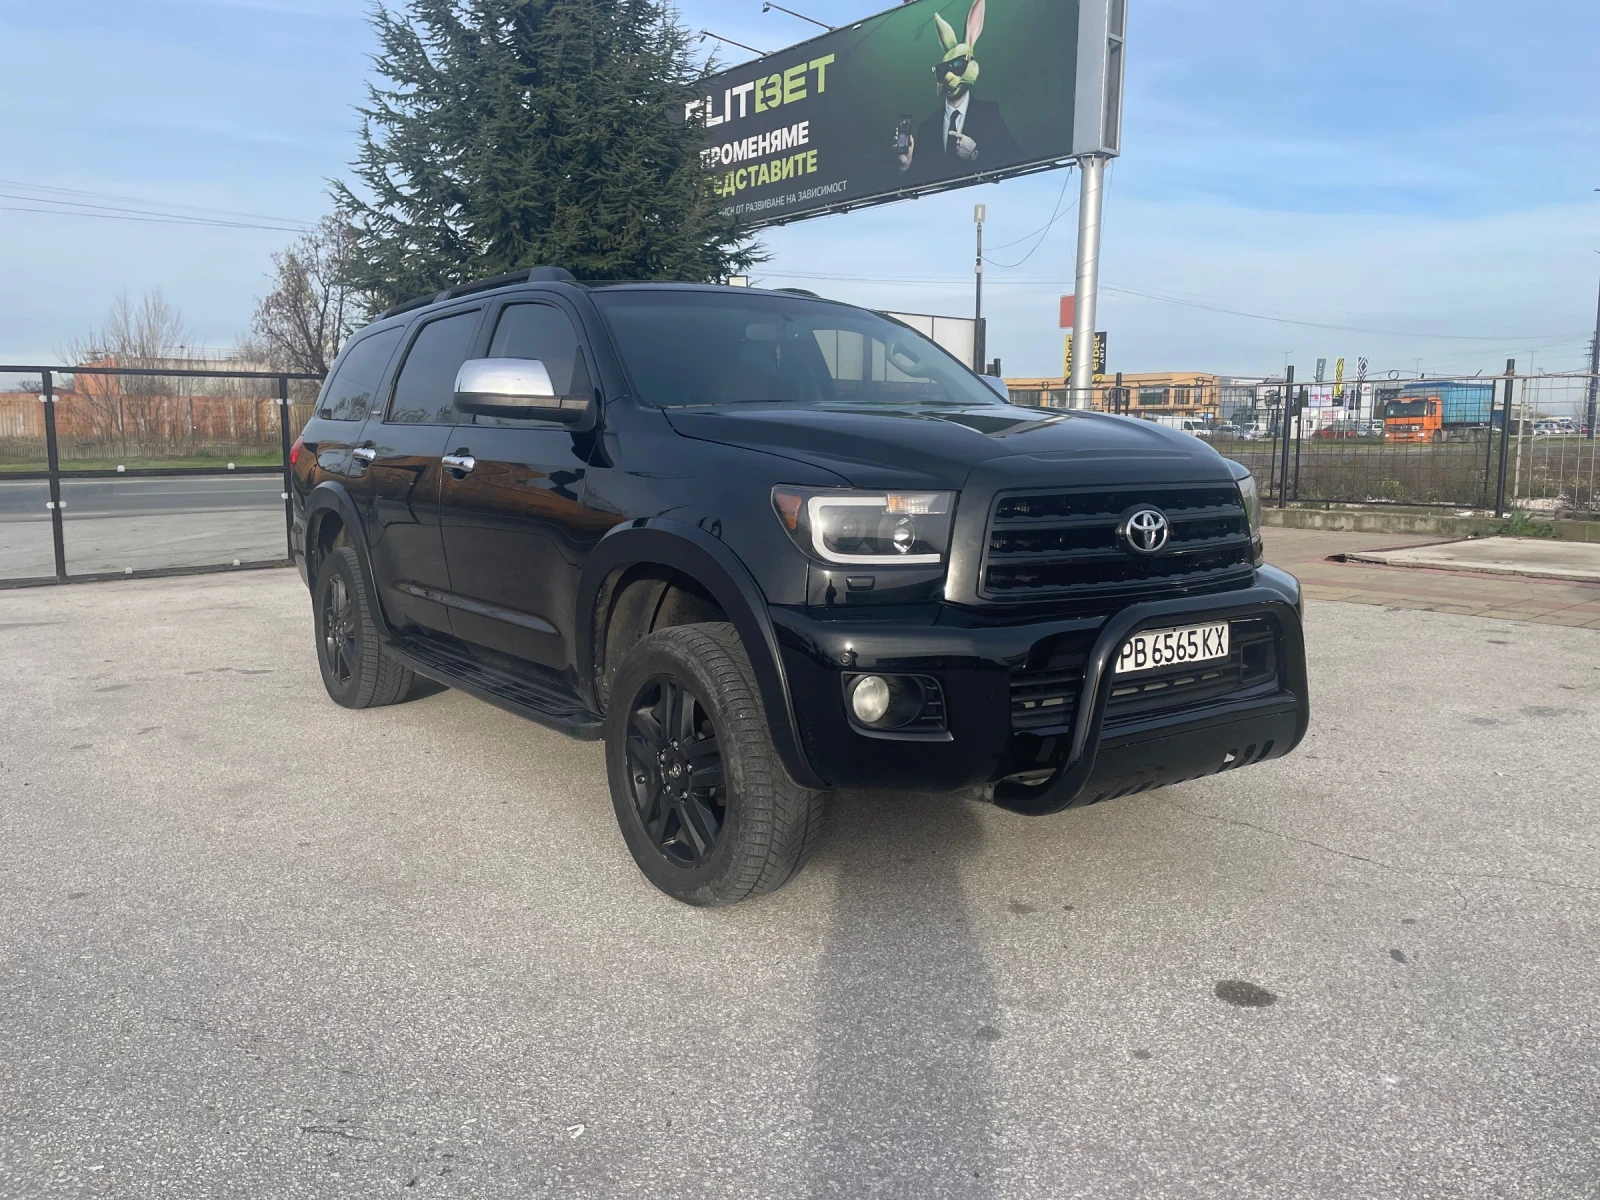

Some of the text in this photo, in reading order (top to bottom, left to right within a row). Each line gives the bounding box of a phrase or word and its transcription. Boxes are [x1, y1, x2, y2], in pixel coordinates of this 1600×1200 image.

[718, 180, 848, 217] ИСК ОТ РАЗВИВАНЕ НА ЗАВИСИМОСТ
[1120, 625, 1225, 670] PB 6565 KX
